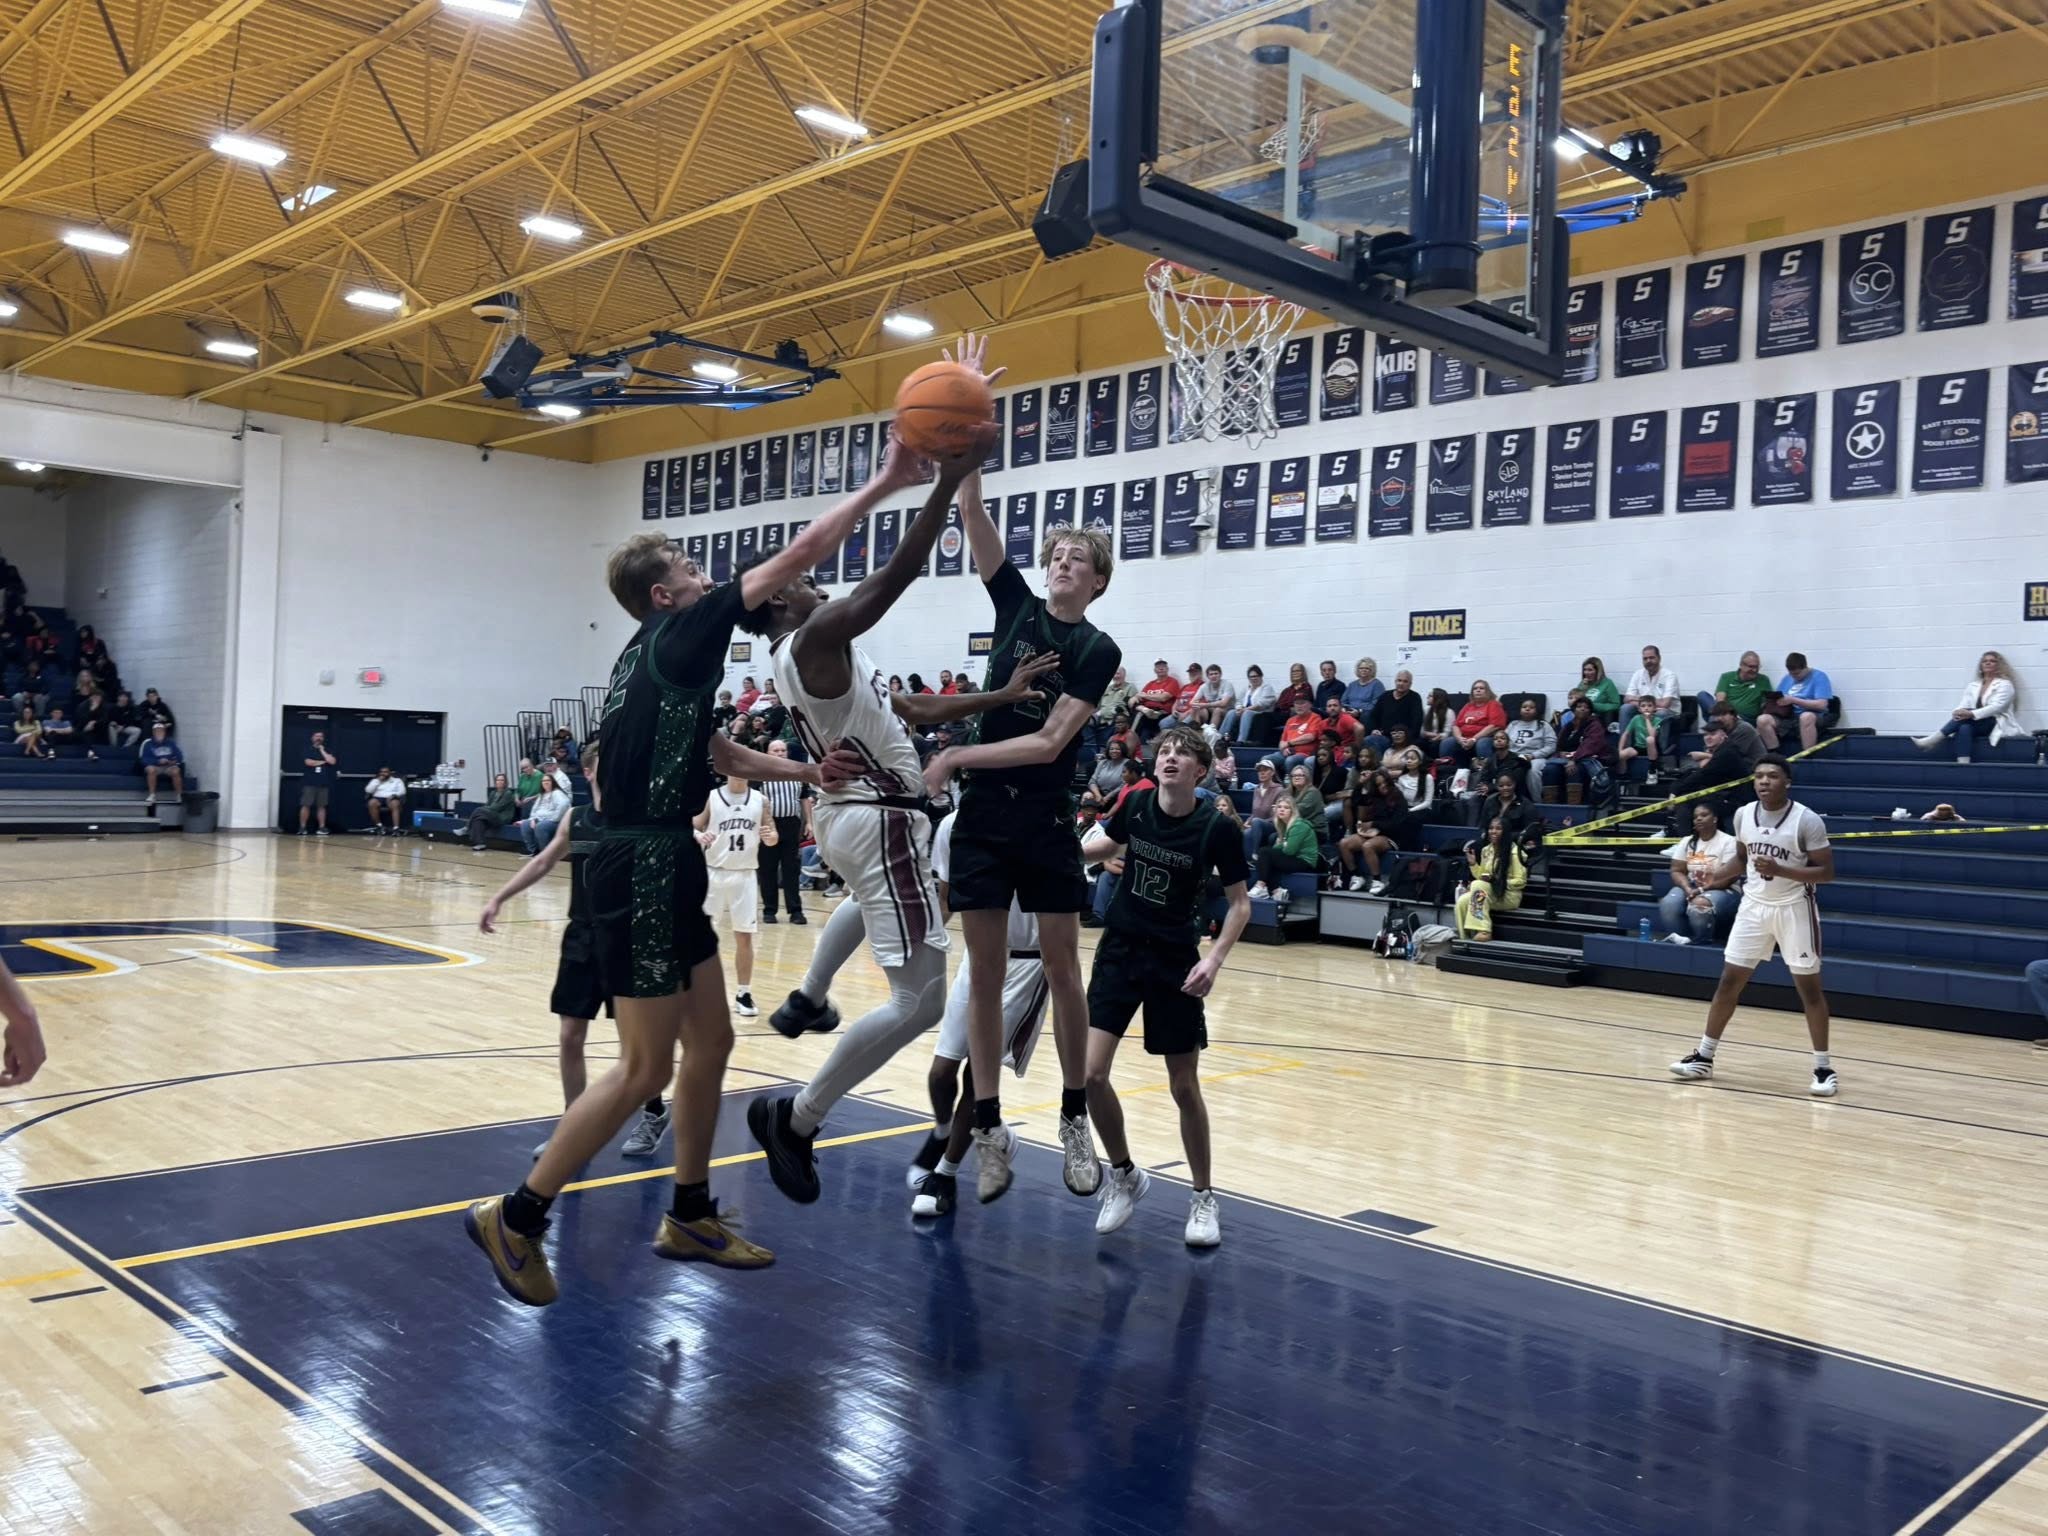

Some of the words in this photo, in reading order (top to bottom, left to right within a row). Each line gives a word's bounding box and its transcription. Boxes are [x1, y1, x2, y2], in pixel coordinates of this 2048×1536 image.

[1946, 217, 1971, 244] S
[1861, 233, 1884, 259] S
[1780, 250, 1802, 276] S
[1704, 264, 1725, 289] S
[1855, 270, 1890, 295] SC
[1634, 277, 1652, 301] S
[1567, 291, 1585, 313] S
[1336, 333, 1351, 354] S
[1286, 344, 1300, 364] S
[1376, 350, 1416, 377] KUB
[1097, 381, 1109, 398] S
[1138, 373, 1150, 391] S
[1940, 378, 1966, 404] S
[1022, 395, 1032, 412] S
[1059, 387, 1070, 404] S
[1854, 390, 1878, 415] S
[1774, 401, 1796, 425] S
[1630, 419, 1648, 441] S
[1699, 411, 1720, 434] S
[800, 436, 808, 450] S
[828, 431, 837, 446] S
[857, 428, 865, 442] S
[1564, 428, 1582, 449] S
[747, 446, 755, 459] S
[773, 440, 781, 454] S
[1444, 442, 1460, 462] S
[1501, 434, 1519, 456] S
[697, 457, 705, 470] S
[722, 451, 730, 465] S
[1332, 456, 1347, 475] S
[1386, 449, 1402, 469] S
[651, 464, 657, 477] S
[673, 461, 681, 474] S
[1282, 463, 1296, 482] S
[1176, 476, 1188, 495] S
[1234, 469, 1248, 487] S
[1554, 481, 1572, 489] School
[1573, 480, 1590, 488] Board
[1055, 493, 1066, 509] S
[1093, 489, 1105, 506] S
[1133, 483, 1145, 501] S
[1017, 498, 1027, 514] S
[883, 515, 892, 530] S
[947, 508, 956, 523] S
[718, 536, 726, 549] S
[743, 531, 752, 545] S
[769, 528, 777, 541] S
[694, 539, 701, 552] S
[1412, 614, 1463, 636] HOME
[729, 834, 744, 851] 14
[1131, 860, 1170, 904] 12
